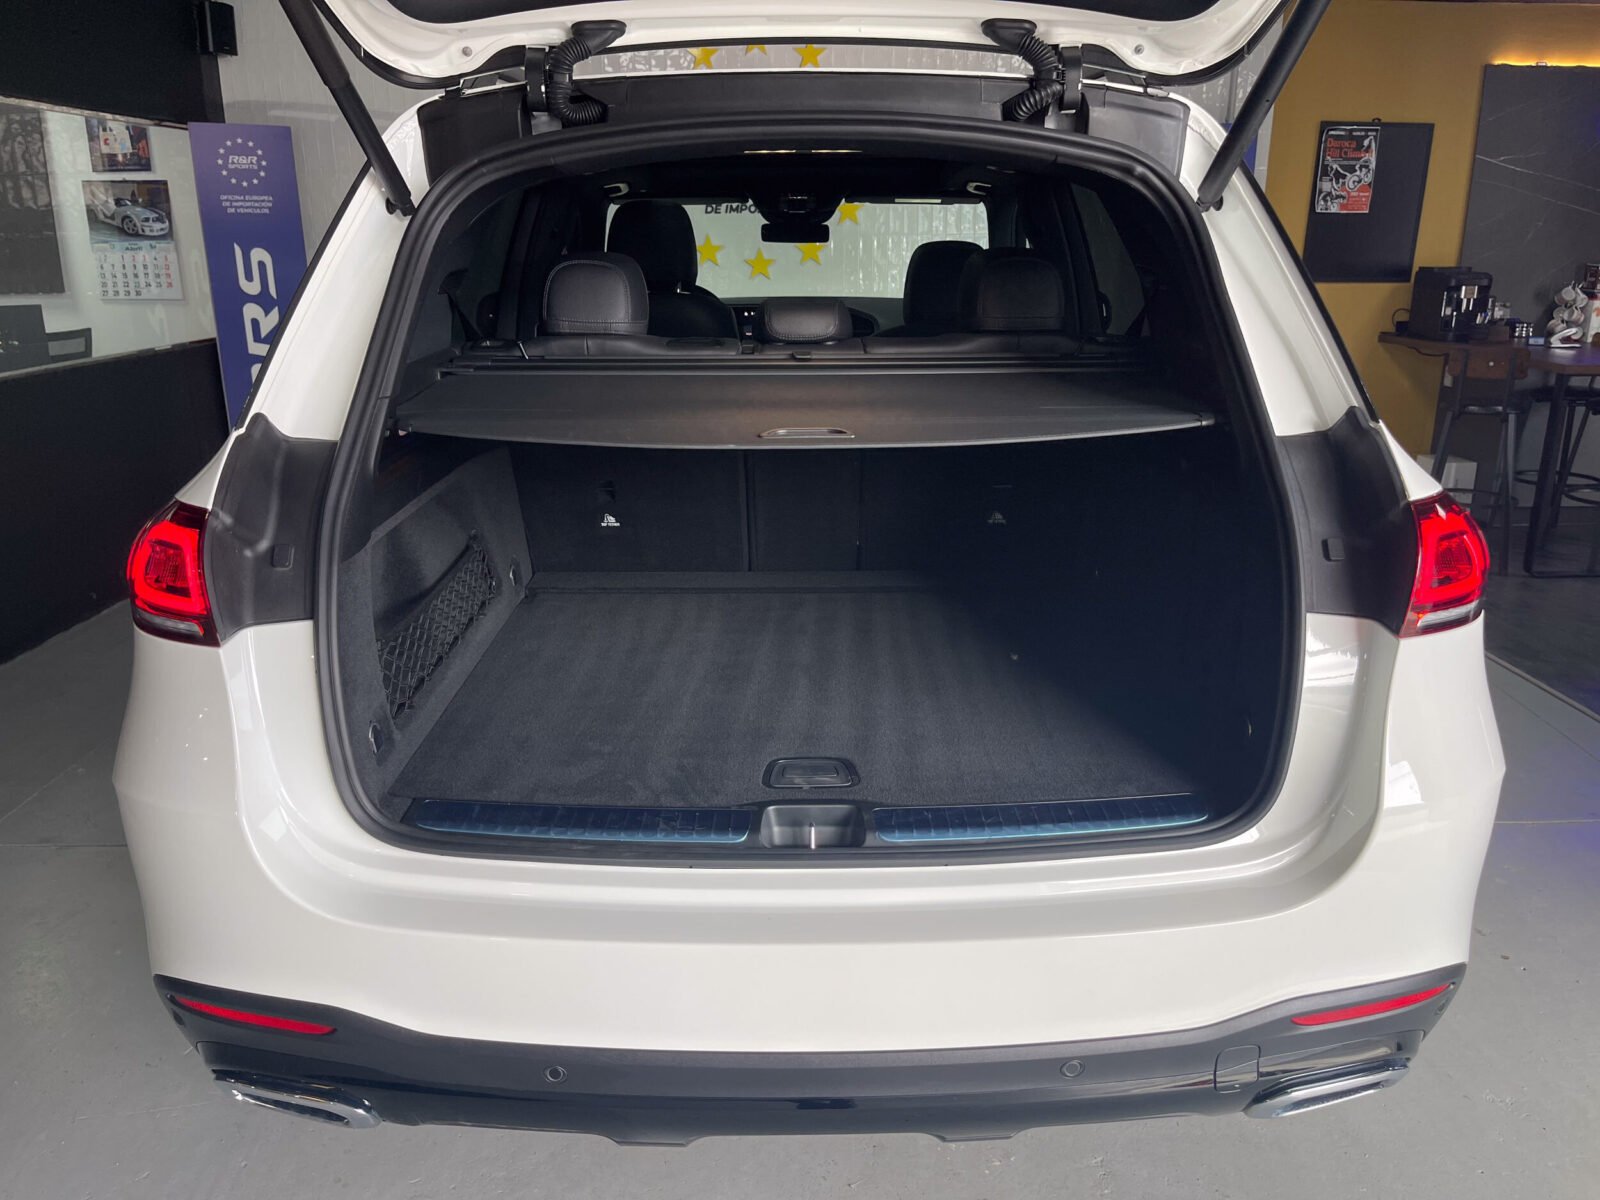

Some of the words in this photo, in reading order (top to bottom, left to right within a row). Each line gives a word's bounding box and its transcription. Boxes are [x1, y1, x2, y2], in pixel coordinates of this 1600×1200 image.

[228, 155, 258, 164] R&R
[705, 204, 721, 214] DE
[725, 204, 760, 214] IMPO
